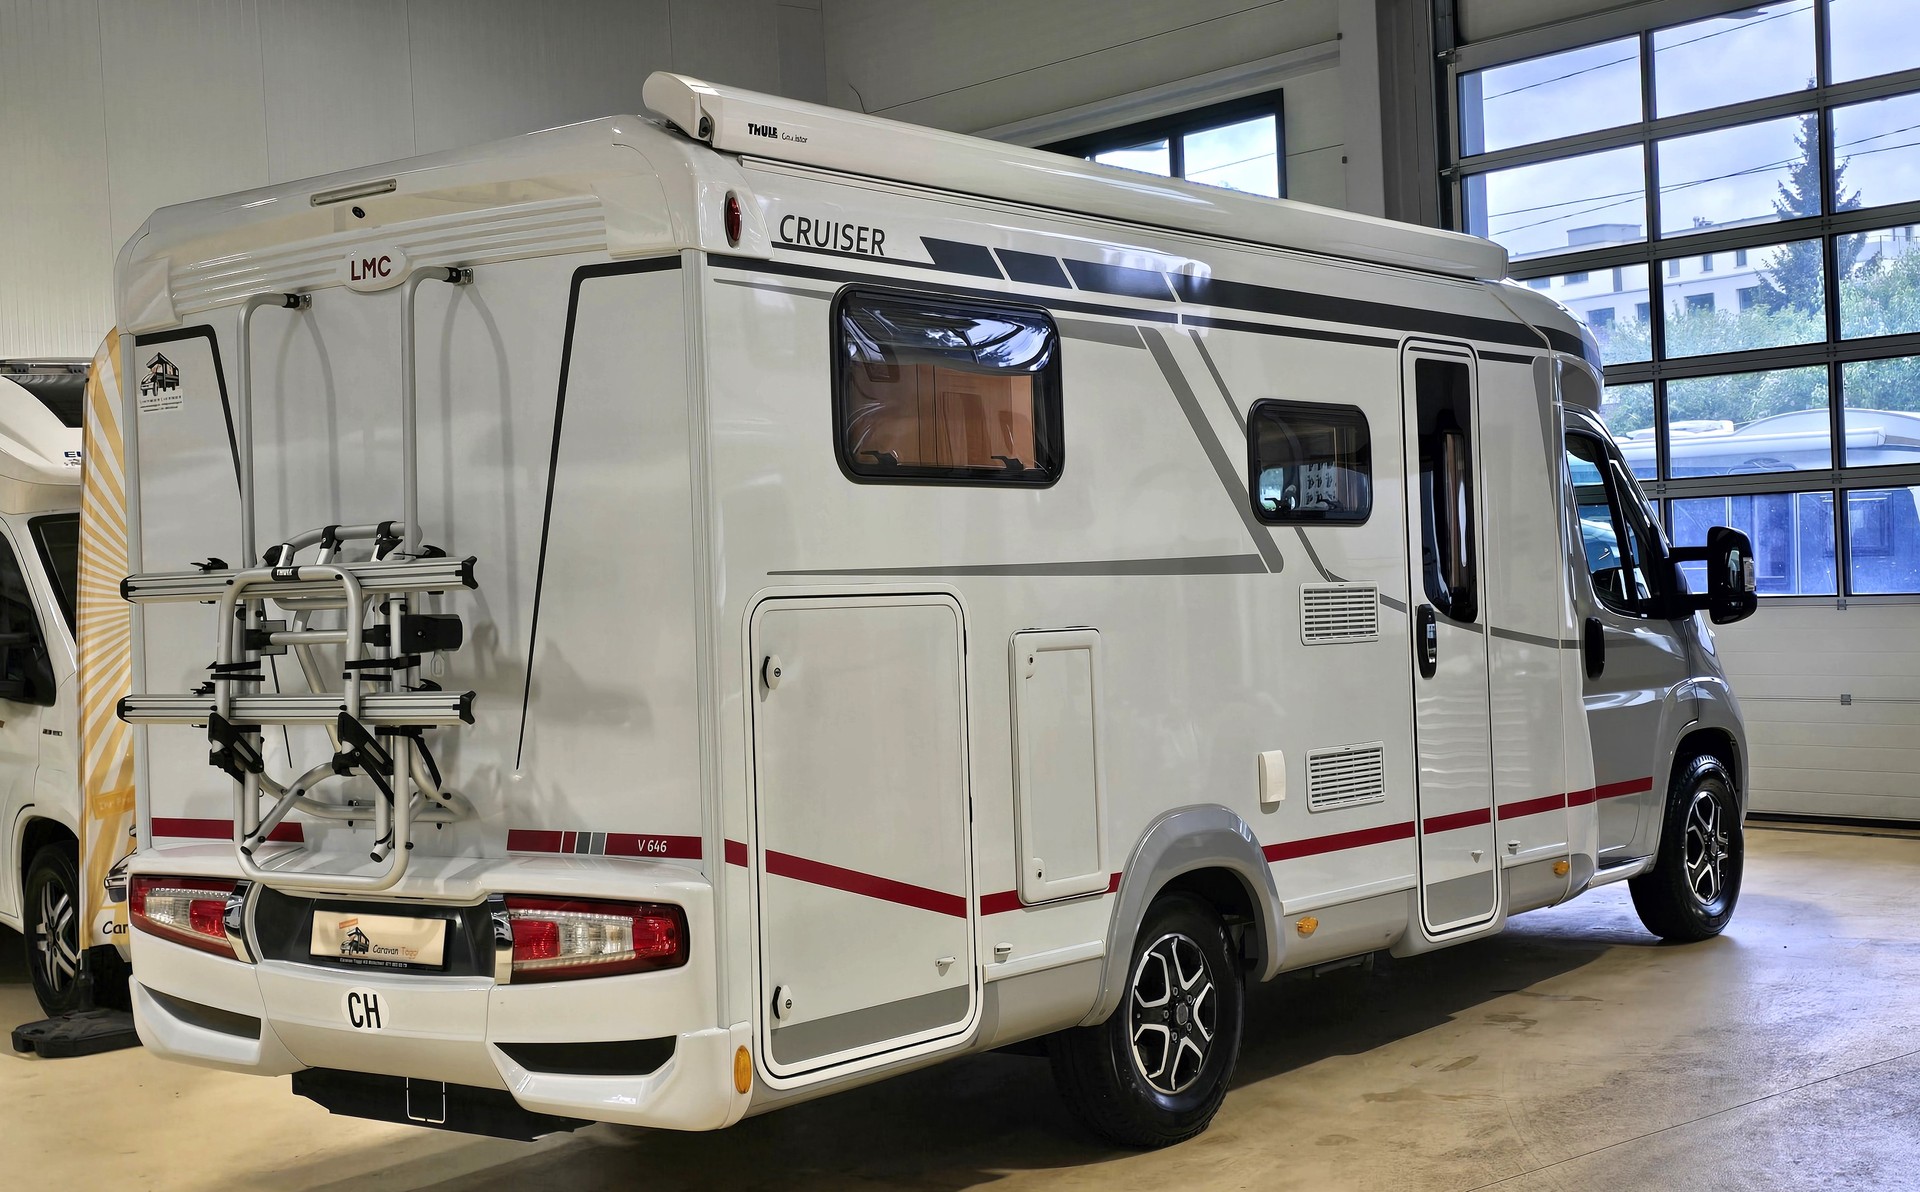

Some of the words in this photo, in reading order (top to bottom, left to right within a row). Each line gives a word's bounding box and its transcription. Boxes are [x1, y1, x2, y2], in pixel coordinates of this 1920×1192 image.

[748, 122, 778, 139] THULE
[779, 214, 885, 256] CRUISER
[351, 255, 391, 281] LMC
[637, 839, 646, 852] V
[647, 839, 667, 853] 646
[102, 920, 129, 935] Car
[372, 944, 399, 956] Caravan
[347, 991, 382, 1029] CH
